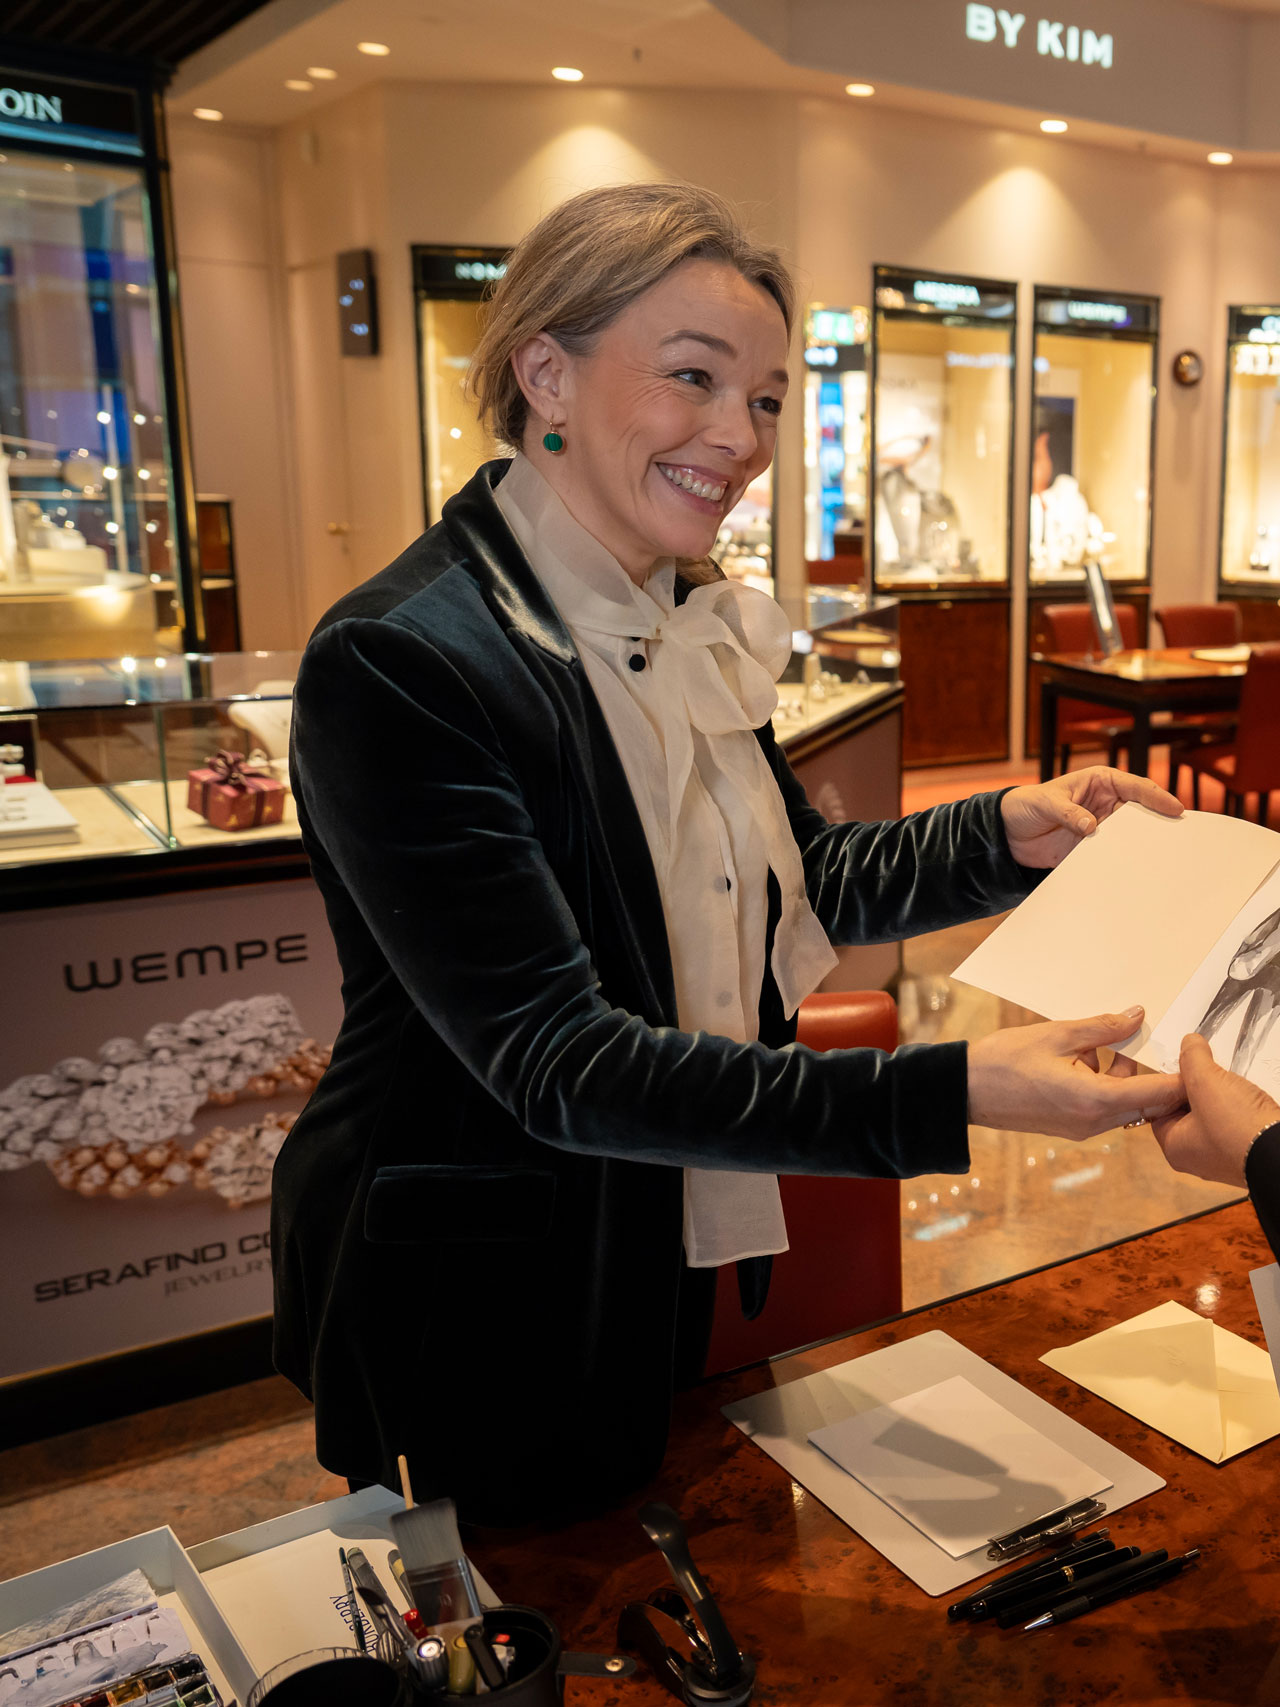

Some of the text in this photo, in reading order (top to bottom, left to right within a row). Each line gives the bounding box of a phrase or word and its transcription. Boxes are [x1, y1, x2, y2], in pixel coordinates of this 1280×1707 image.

[966, 2, 1114, 69] BY KIM
[64, 933, 308, 992] WEMPE
[34, 1242, 227, 1303] SERAFINO
